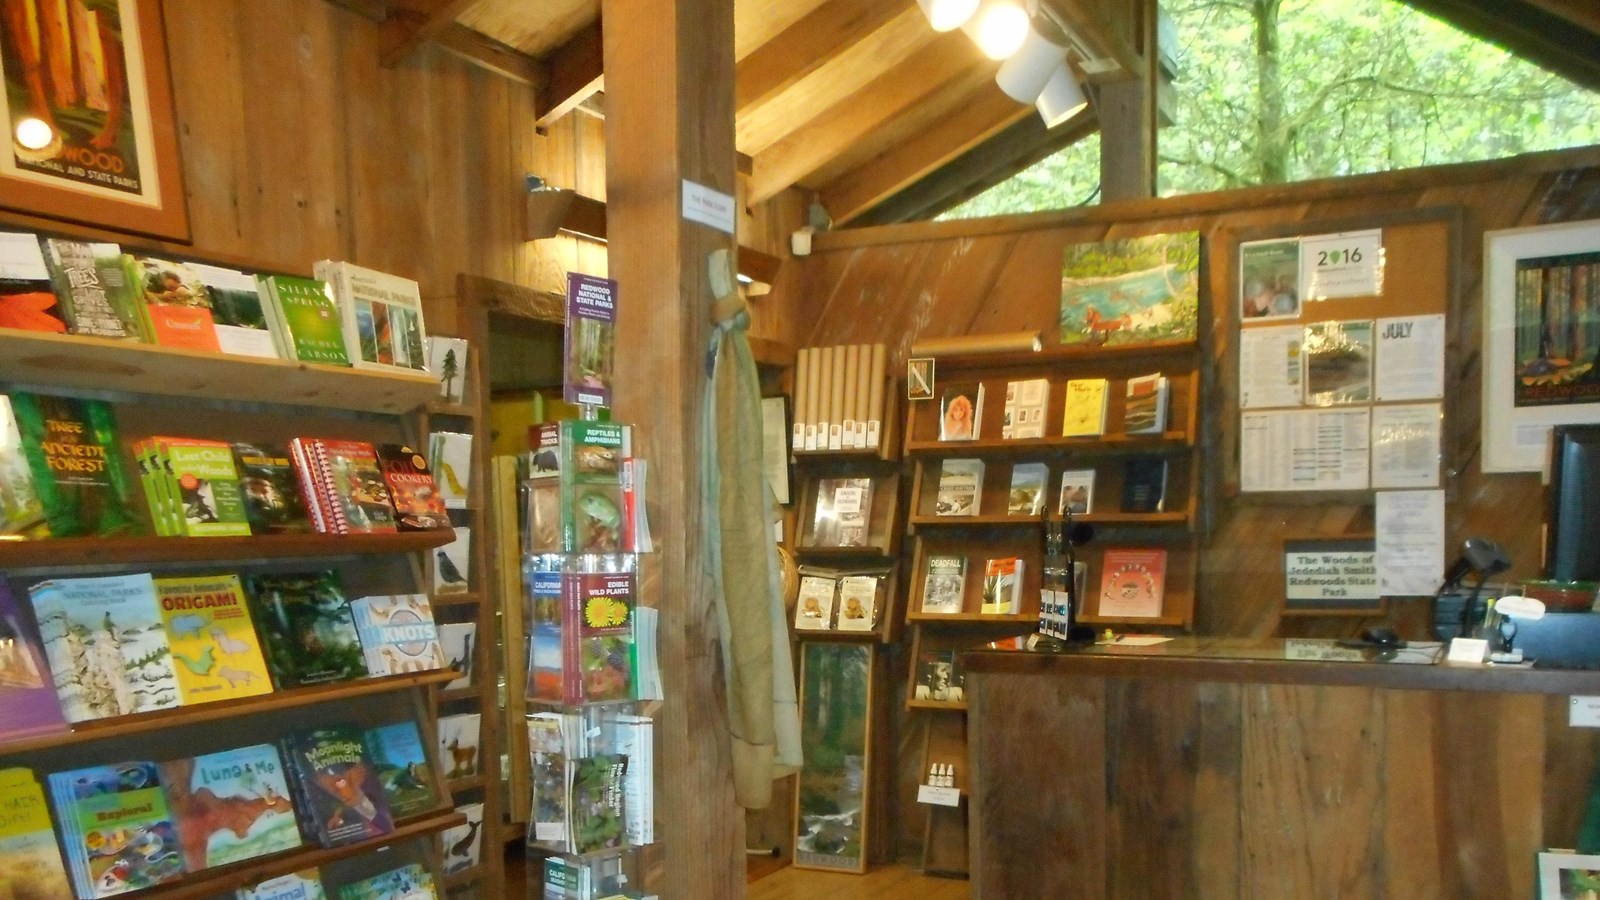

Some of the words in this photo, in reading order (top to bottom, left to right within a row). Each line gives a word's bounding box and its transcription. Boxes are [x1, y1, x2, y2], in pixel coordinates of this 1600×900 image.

[67, 165, 86, 178] AND
[87, 169, 112, 184] STATE
[113, 174, 139, 190] PARKS
[64, 267, 100, 289] TREES
[580, 283, 611, 295] REDWOOD
[578, 290, 606, 301] NATIONAL
[285, 296, 330, 308] SPRING
[575, 296, 595, 306] STATE
[595, 299, 614, 309] PARKS
[1382, 322, 1414, 340] JULY
[298, 349, 348, 361] CARSON
[45, 419, 84, 434] TREE
[586, 429, 615, 438] REPTILES
[584, 436, 621, 445] AMPHIBIANS
[42, 441, 105, 457] ANCIENT
[48, 457, 104, 473] FOREST
[198, 464, 233, 476] Woods
[390, 473, 433, 484] COOKERY
[930, 559, 961, 568] DEADFALL
[1296, 556, 1318, 565] The
[1322, 556, 1358, 565] Woods
[1362, 555, 1375, 565] of
[1288, 566, 1340, 577] Jedediah
[1343, 566, 1377, 576] Smith
[1289, 577, 1346, 586] Redwoods
[1347, 577, 1377, 586] State
[111, 586, 143, 597] PARKS
[1321, 588, 1348, 597] Park
[161, 592, 238, 611] ORIGAMI
[382, 625, 435, 642] KNOTS
[304, 742, 363, 762] Moonlight
[312, 753, 362, 772] Animals
[201, 763, 242, 785] Luna
[244, 763, 253, 774] &
[254, 759, 275, 776] Me
